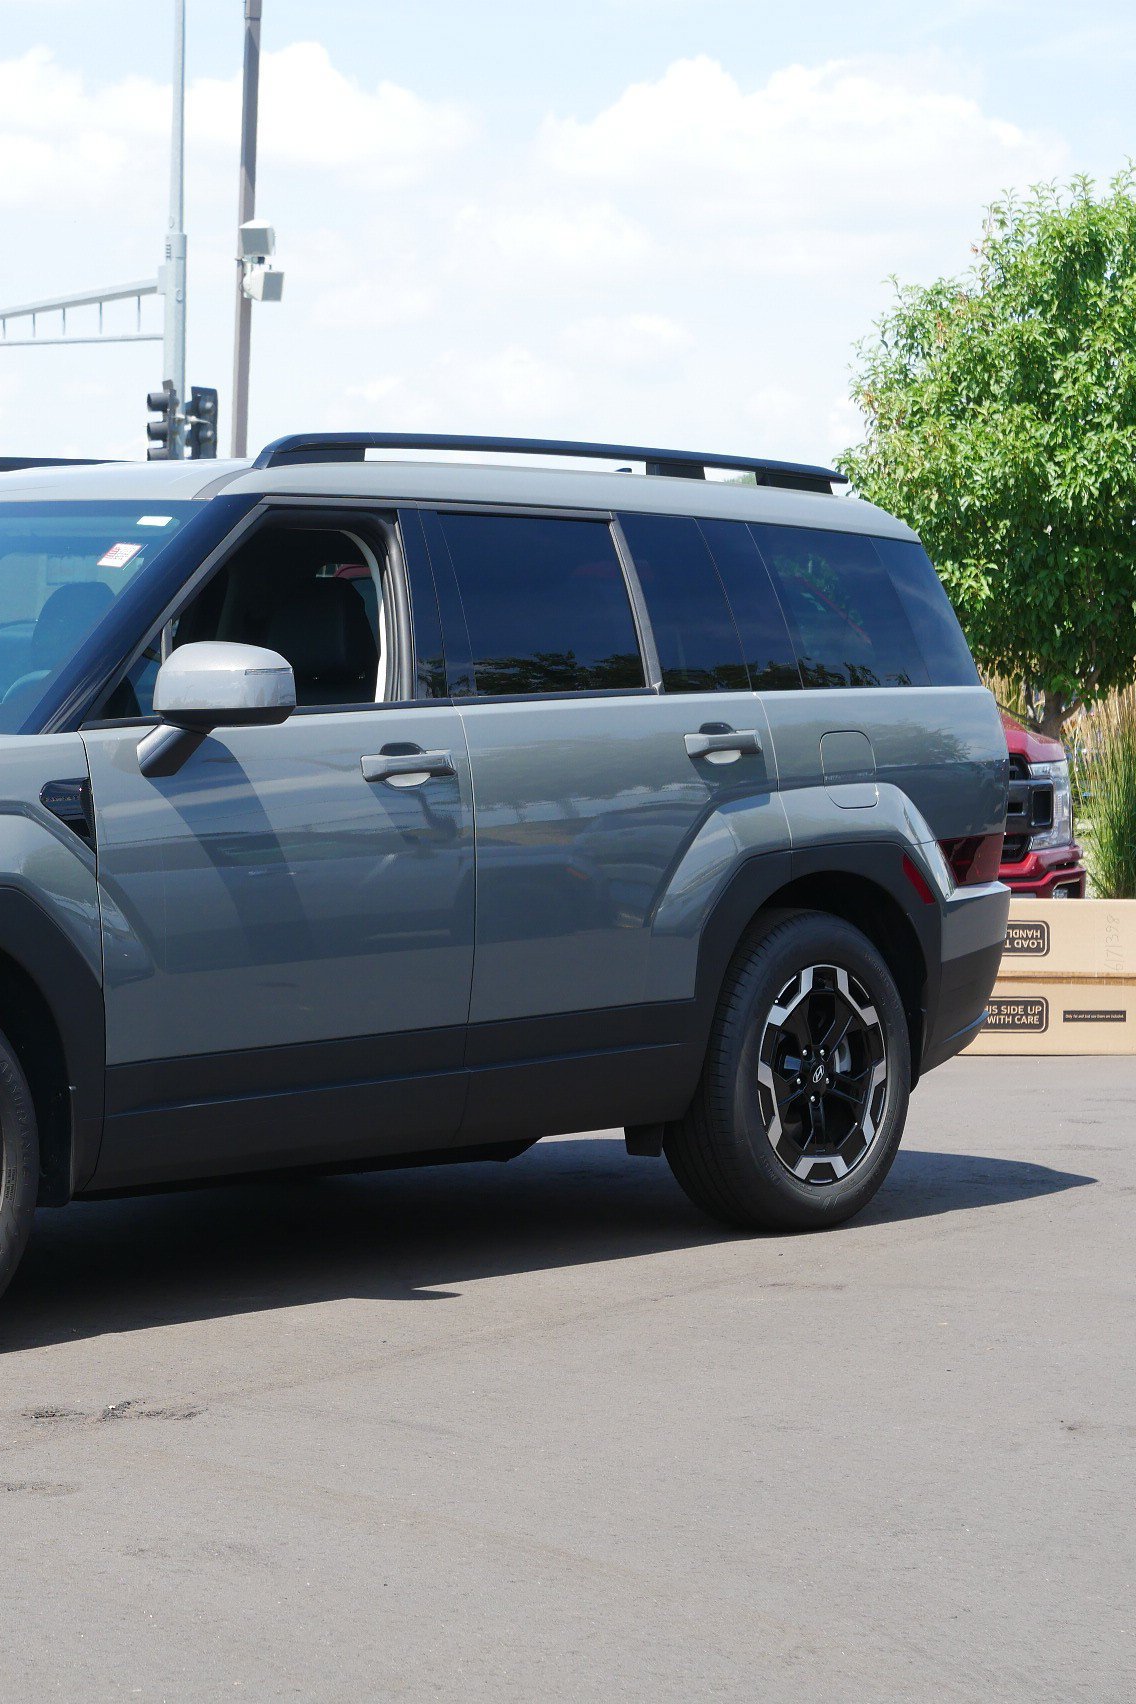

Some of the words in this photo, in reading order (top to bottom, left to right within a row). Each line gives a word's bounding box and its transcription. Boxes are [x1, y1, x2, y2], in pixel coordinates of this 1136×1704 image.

[1004, 929, 1041, 938] HANDL
[1014, 939, 1043, 949] LOAD
[1000, 1005, 1025, 1014] SIDE
[1027, 1005, 1042, 1014] UP
[987, 1015, 1012, 1024] WITH
[1014, 1015, 1040, 1024] CARE
